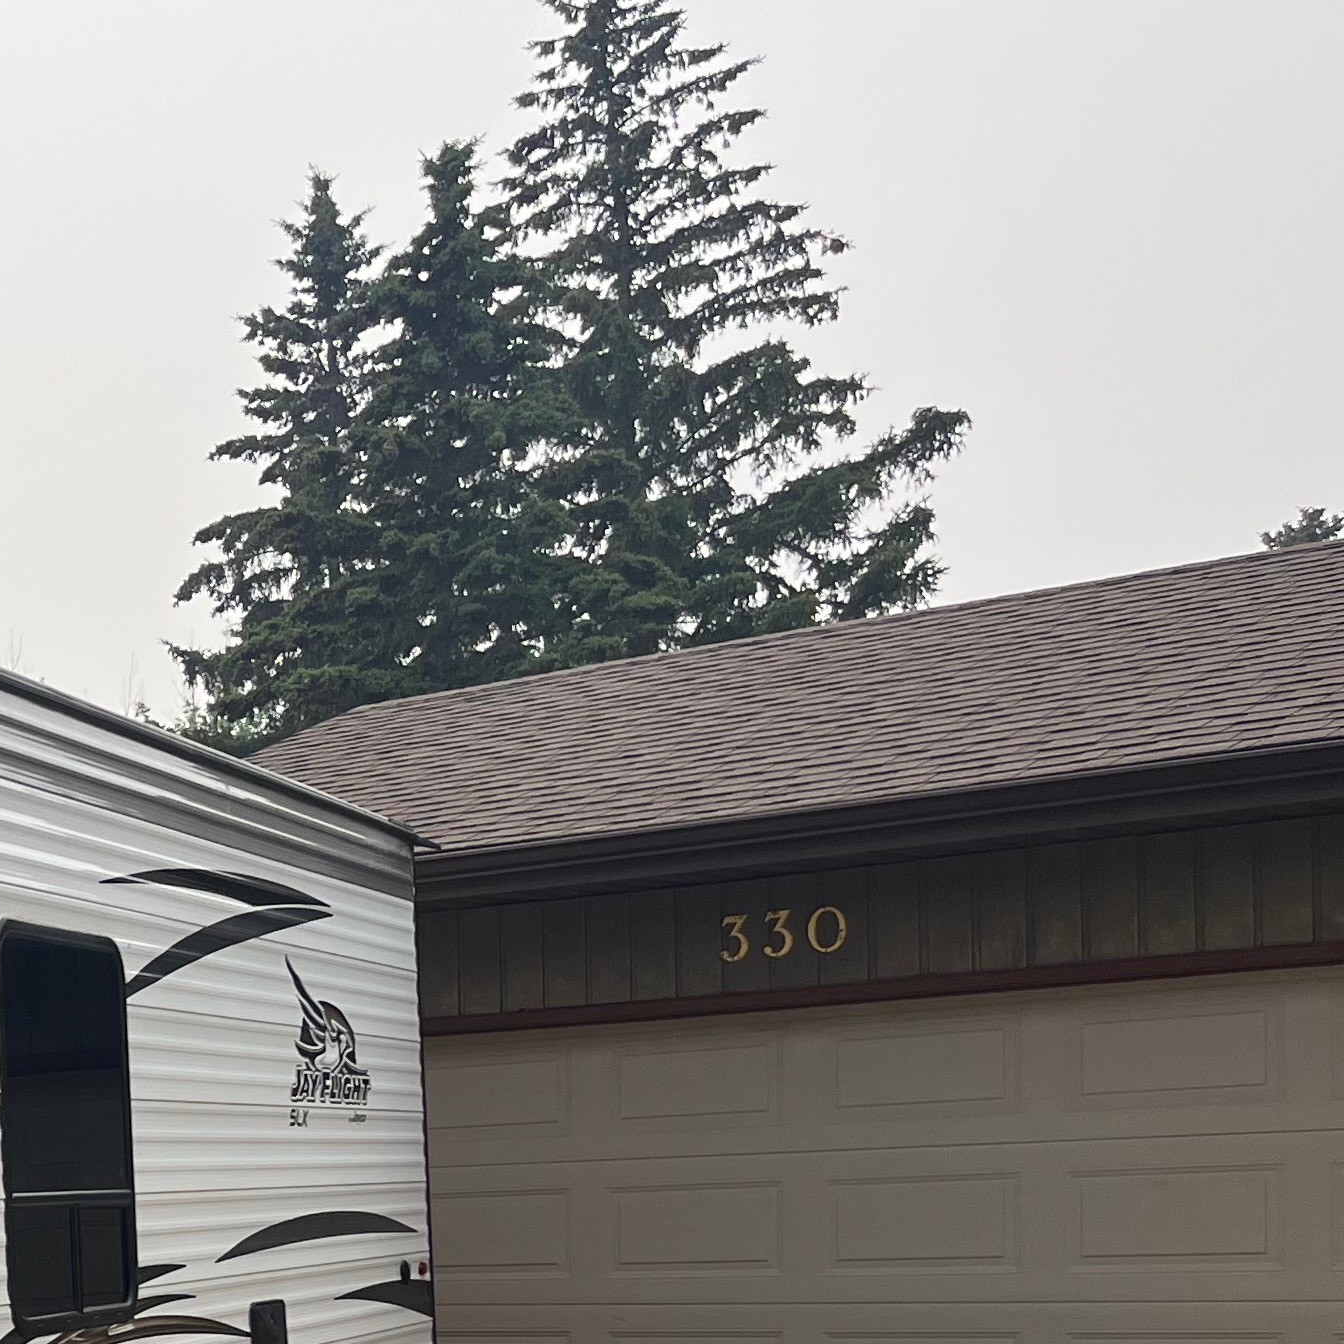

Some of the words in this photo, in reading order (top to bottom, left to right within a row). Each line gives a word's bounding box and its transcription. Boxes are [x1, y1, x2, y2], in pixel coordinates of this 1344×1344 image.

[719, 905, 848, 962] 330
[290, 1064, 319, 1102] JAY
[320, 1067, 371, 1105] FLIGHT
[289, 1108, 309, 1127] SLX
